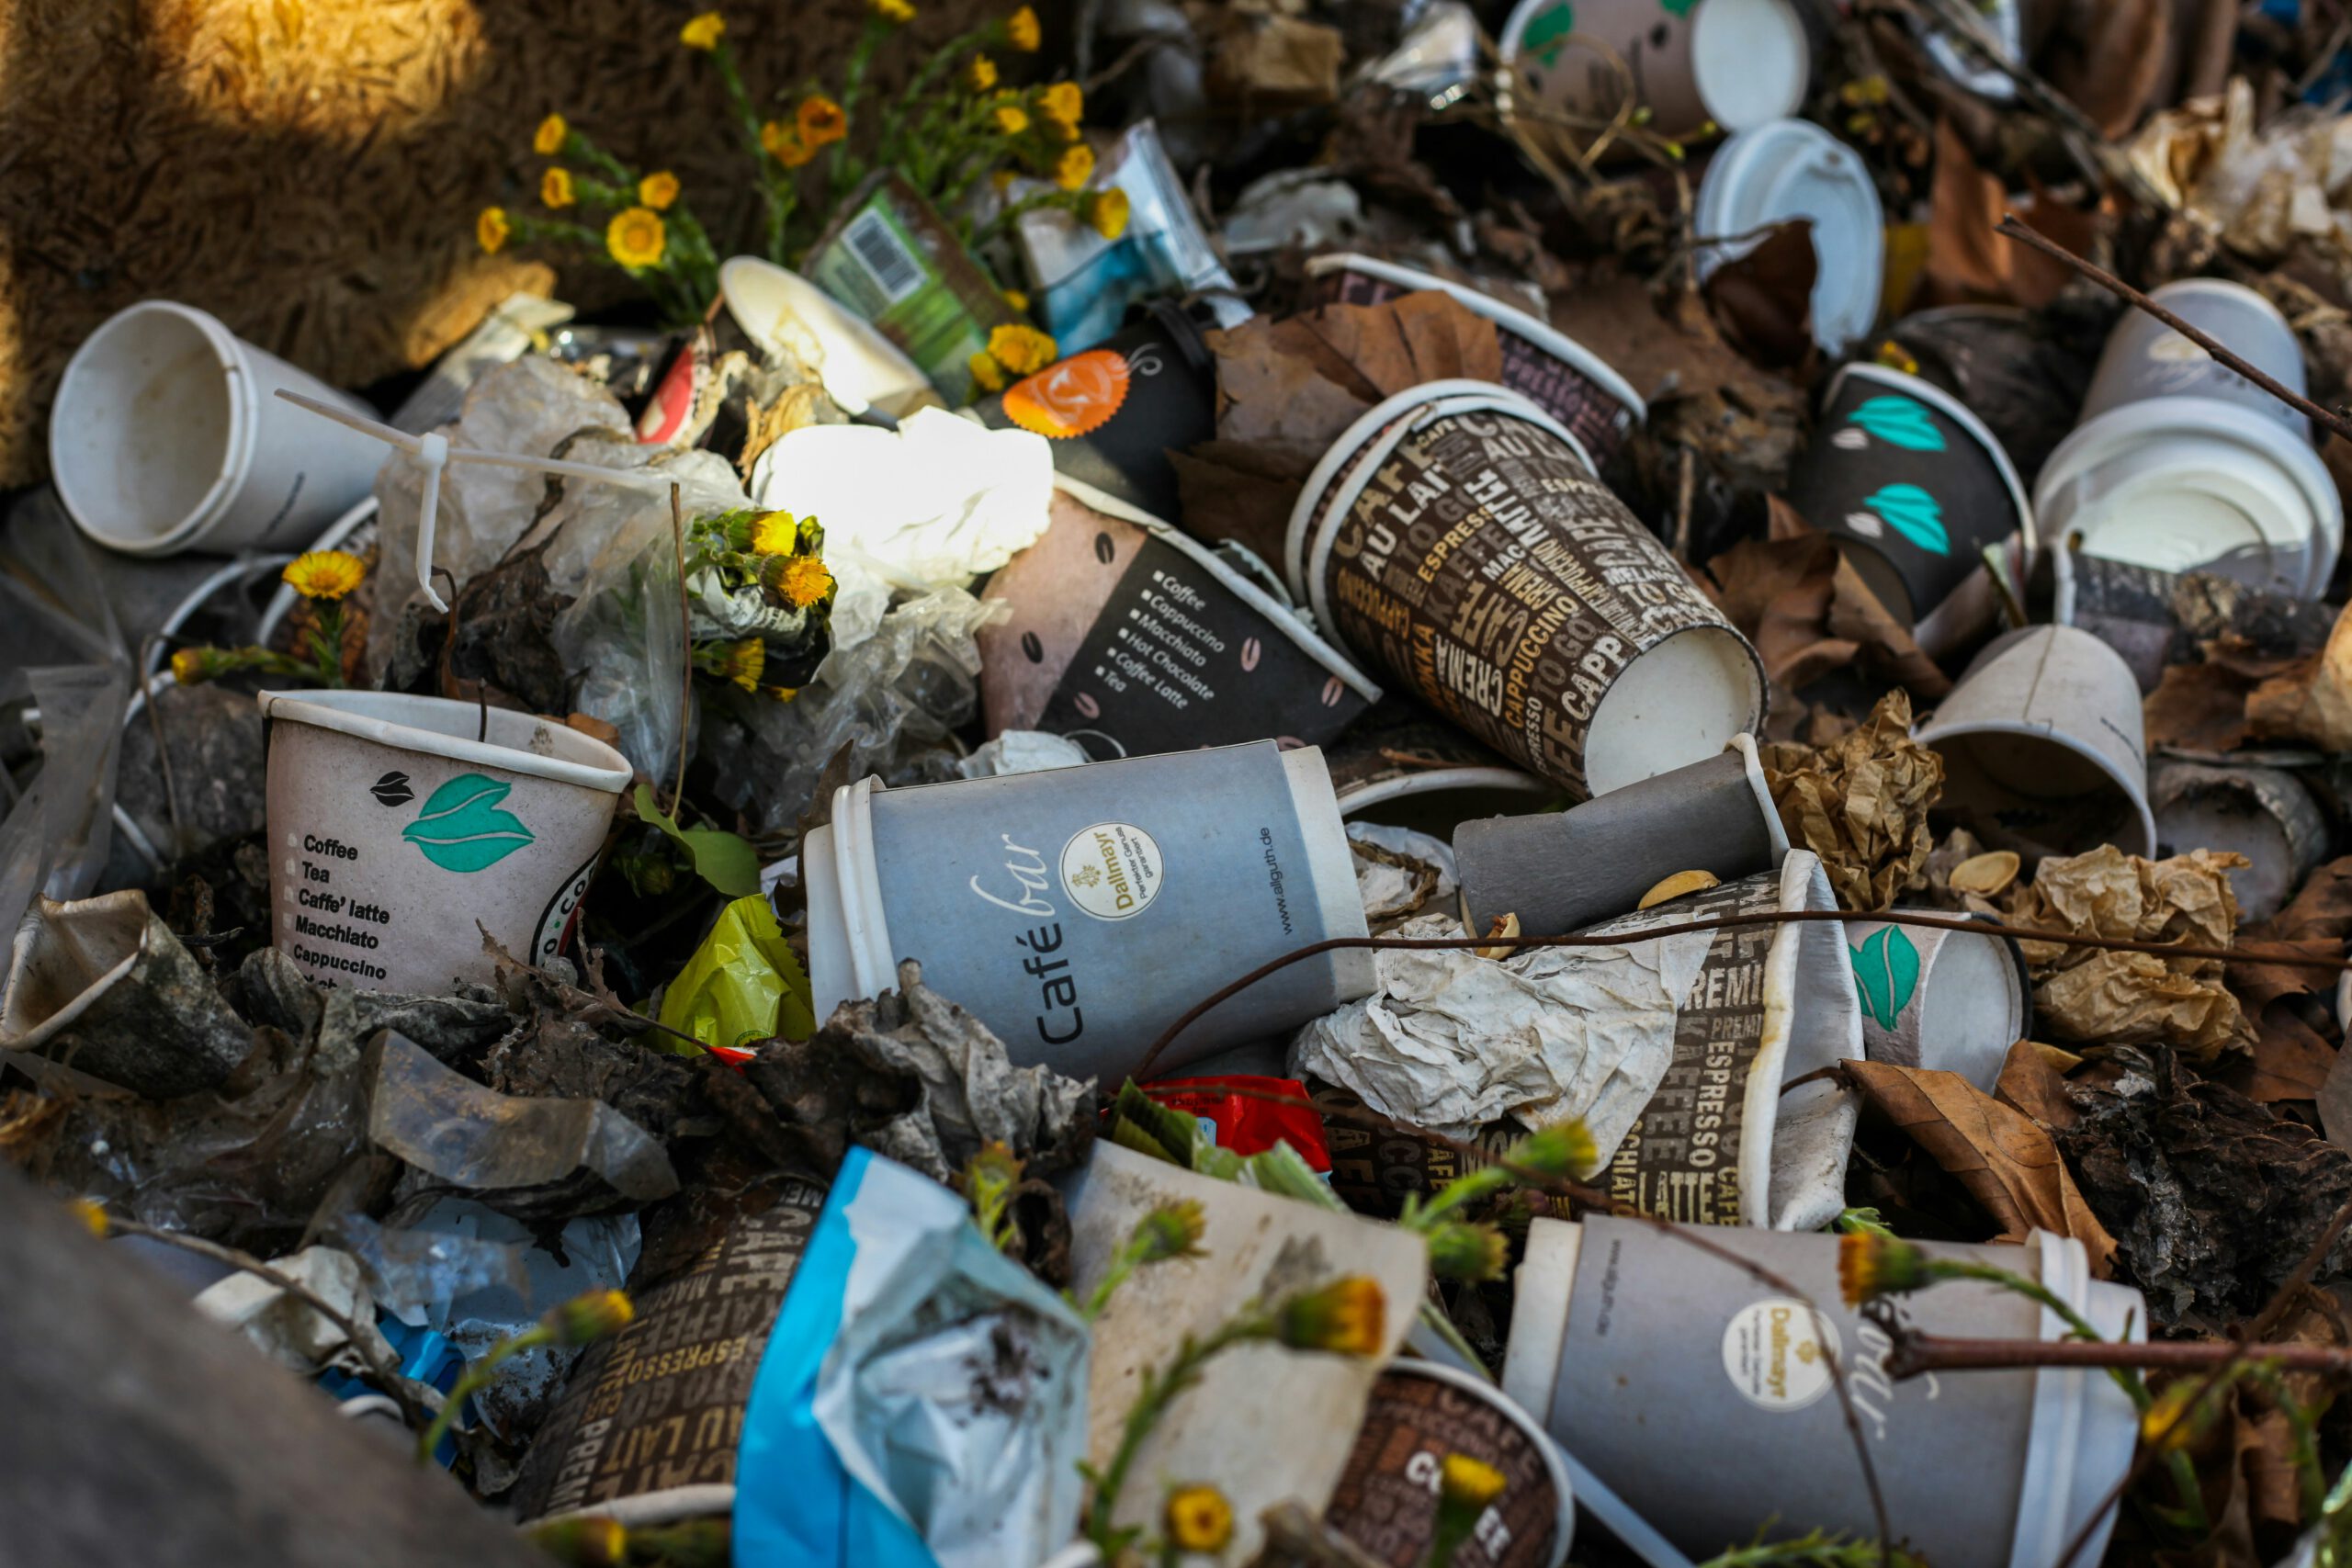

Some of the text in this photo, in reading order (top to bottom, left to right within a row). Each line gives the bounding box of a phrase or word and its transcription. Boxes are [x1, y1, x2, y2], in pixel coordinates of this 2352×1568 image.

[1482, 435, 1532, 462] AU
[1334, 438, 1434, 558] CAFE
[1360, 523, 1397, 583] AU
[1396, 522, 1438, 565] TO
[1161, 576, 1205, 612] Coffee
[1498, 560, 1560, 611] CREMA
[1617, 581, 1668, 608] TO
[1137, 614, 1207, 667] Macchiato
[1150, 595, 1225, 653] Cappuccino
[1451, 580, 1530, 668] CAFE
[1103, 670, 1127, 693] Tea
[1115, 652, 1189, 710] Coffee Latte
[1126, 632, 1215, 701] Hot Chocolate
[1435, 633, 1503, 717] CREMA
[1505, 595, 1580, 729] CAPPUCCINO
[1532, 617, 1598, 701] TO GO
[1561, 636, 1630, 722] CAPP
[302, 861, 330, 884] Tea
[304, 834, 358, 861] Coffee
[1093, 831, 1135, 910] Dallmayr
[1114, 826, 1148, 900] Perfekter Genuss
[1130, 837, 1154, 879] garantiert
[1260, 826, 1294, 937] www.allguth.de
[295, 915, 379, 949] Macchiato
[348, 899, 390, 925] latte
[970, 833, 1083, 1045] Café bar
[293, 943, 387, 980] Cappuccino
[1643, 1015, 1709, 1163] KAFFEE
[1689, 1041, 1736, 1168] ESPRESSO
[1638, 1170, 1715, 1225] LATTE
[628, 1335, 747, 1382] ESPRESSO
[1766, 1306, 1792, 1399] Dallmayr
[622, 1378, 678, 1419] GO
[600, 1413, 687, 1472] LAIT
